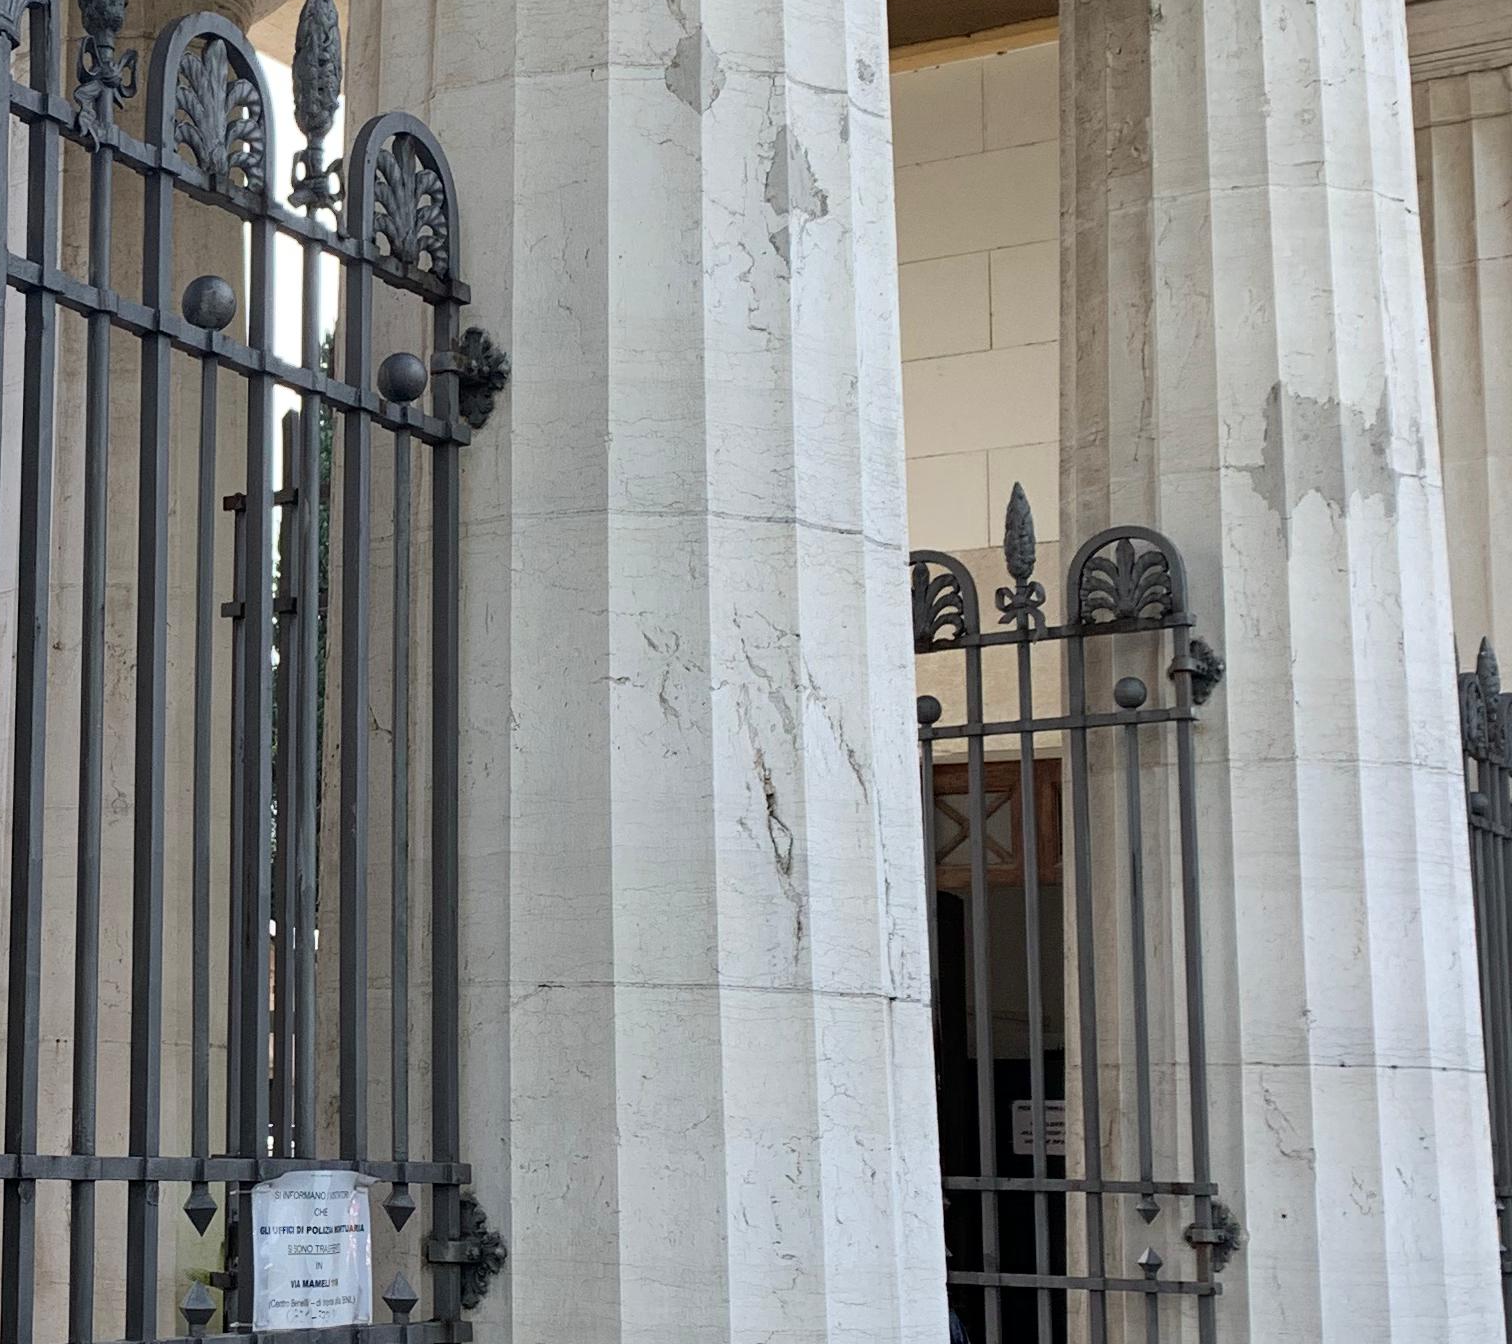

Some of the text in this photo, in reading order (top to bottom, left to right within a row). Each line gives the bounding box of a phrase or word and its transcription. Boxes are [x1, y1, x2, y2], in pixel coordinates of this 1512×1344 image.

[282, 1190, 326, 1200] INFORMANO
[313, 1207, 329, 1217] CHE
[260, 1226, 271, 1235] GLI
[272, 1226, 295, 1235] UFFICI
[296, 1226, 304, 1235] DI
[315, 1261, 324, 1270] IN
[290, 1279, 301, 1289] VIA
